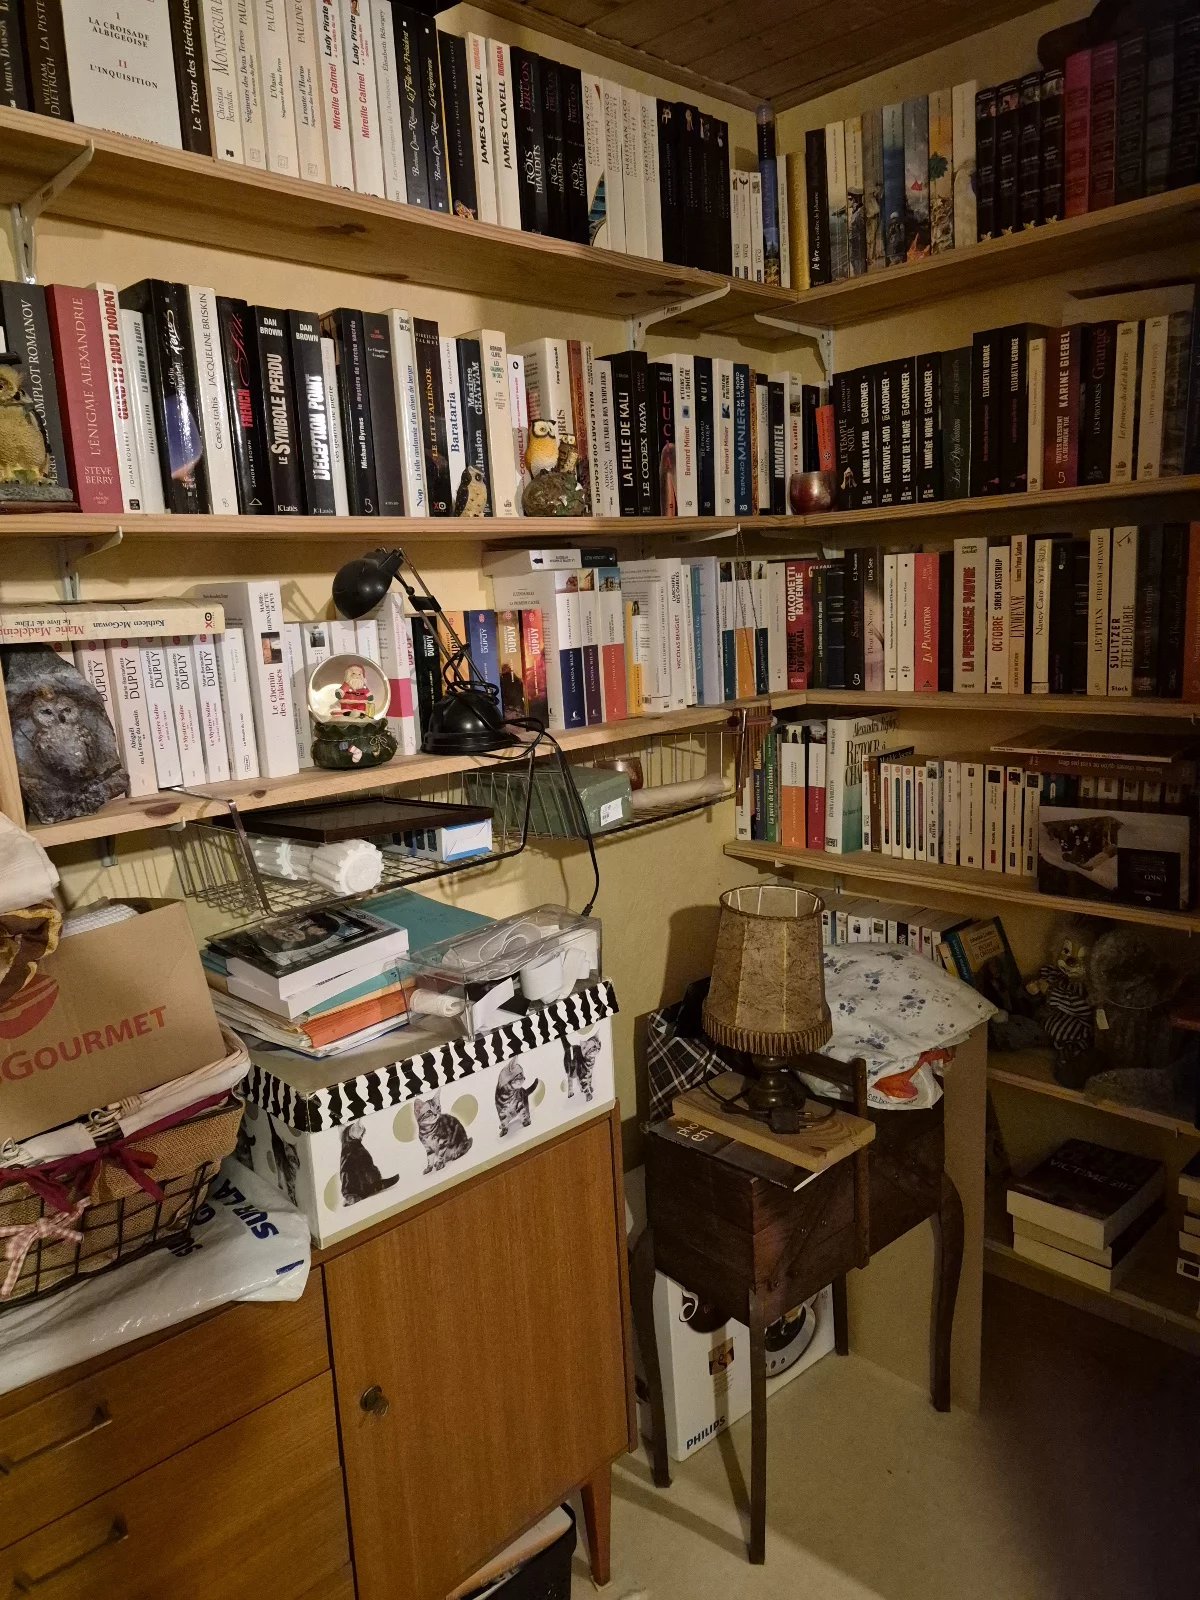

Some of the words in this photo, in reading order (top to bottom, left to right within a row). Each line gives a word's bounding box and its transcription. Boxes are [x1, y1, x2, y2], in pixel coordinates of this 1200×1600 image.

[88, 16, 100, 25] LA
[103, 21, 150, 41] CROISADE
[182, 0, 196, 57] Hérétiques
[321, 6, 330, 32] Pirate
[349, 14, 358, 41] Pirate
[39, 36, 49, 50] LA
[92, 26, 148, 48] ALBIGEOISE
[324, 34, 333, 56] Lady
[186, 59, 197, 78] des
[351, 43, 360, 65] Lady
[40, 63, 50, 105] WILLIAM
[47, 57, 61, 115] DIETRICH
[90, 64, 158, 89] L'INQUISITION
[329, 63, 339, 95] Calmel
[357, 72, 368, 104] Calmel
[188, 81, 199, 114] Trésor
[215, 86, 226, 120] Christian
[224, 89, 235, 123] Bernadac
[475, 73, 485, 123] CLAVELL
[499, 80, 509, 130] CLAVELL
[193, 117, 201, 131] Le
[331, 97, 341, 131] Mireille
[360, 106, 370, 139] Mireille
[479, 125, 489, 164] JAMES
[502, 131, 513, 170] JAMES
[102, 289, 118, 330] RÔDENT
[199, 292, 211, 330] BRISKIN
[263, 317, 277, 326] DAN
[72, 297, 93, 387] ALEXANDRIE
[260, 326, 283, 337] BROWN
[295, 332, 319, 342] BROWN
[299, 323, 313, 332] DAN
[110, 333, 124, 365] LOUPS
[202, 332, 217, 386] JACQUELINE
[1011, 337, 1019, 362] GEORGE
[1059, 331, 1070, 367] GIEBEL
[114, 367, 125, 383] LES
[267, 353, 285, 393] PERDU
[467, 367, 475, 407] Maxime
[471, 361, 483, 415] CHATTAM
[700, 373, 708, 402] NUIT
[924, 370, 933, 407] GARDNER
[982, 369, 990, 397] ELIZABETH
[1058, 370, 1070, 408] KARINE
[116, 385, 129, 420] QUAND
[425, 367, 436, 423] D'ALIÉNOR
[619, 392, 629, 418] KALI
[882, 378, 890, 414] GARDNER
[902, 372, 910, 409] GARDNER
[85, 390, 102, 456] L'ÉNIGME
[210, 396, 220, 420] trahis
[447, 392, 460, 452] Barataria
[639, 401, 647, 433] MAYA
[213, 421, 223, 450] Cœurs
[270, 397, 291, 455] SYMBOLE
[621, 420, 630, 436] DE
[737, 407, 747, 460] MINIER
[839, 419, 847, 452] TEMPLE
[847, 426, 855, 452] NOIR
[902, 420, 911, 444] L'ANGE
[924, 417, 932, 438] NOIRE
[278, 456, 289, 465] LE
[309, 413, 331, 481] DECEPTION
[431, 443, 438, 457] LE
[517, 428, 526, 475] CONNELLY
[593, 457, 599, 468] SE
[621, 438, 632, 470] FILLE
[641, 437, 650, 478] CODEX
[774, 424, 785, 478] IMMORTEL
[840, 454, 848, 463] LE
[882, 425, 891, 483] RETROUVE-MOI
[902, 444, 911, 453] DE
[84, 466, 112, 475] STEVE
[85, 475, 114, 484] BERRY
[603, 460, 611, 489] ADRIAN
[623, 472, 634, 487] LA
[902, 455, 911, 473] SAUT
[903, 474, 911, 482] LE
[643, 481, 650, 497] LE
[993, 558, 1003, 590] SVEISTRUP
[787, 566, 796, 621] GIACOMETTI
[795, 572, 804, 615] RAVENNE
[55, 625, 85, 637] Marie
[92, 621, 132, 629] McGowan
[133, 619, 165, 628] Kathleen
[506, 625, 517, 653] DUPUY
[921, 606, 931, 650] PLANTATION
[962, 605, 975, 659] PUISSANCE
[991, 615, 1003, 652] OCTOBRE
[426, 635, 434, 657] DUPUY
[481, 628, 489, 654] DUPUY
[530, 627, 541, 655] DUPUY
[1110, 618, 1120, 669] SULITZER
[150, 651, 165, 688] DUPUY
[176, 653, 190, 690] DUPUY
[203, 651, 216, 687] DUPUY
[922, 653, 933, 662] LA
[962, 660, 974, 672] LA
[125, 657, 140, 700] DUPUY
[268, 672, 278, 703] Chemin
[275, 668, 285, 701] Falaises
[271, 705, 278, 715] Le
[278, 703, 286, 717] des
[213, 1178, 246, 1206] LA
[232, 1204, 279, 1239] SUR
[686, 1415, 726, 1450] PHILIPS
